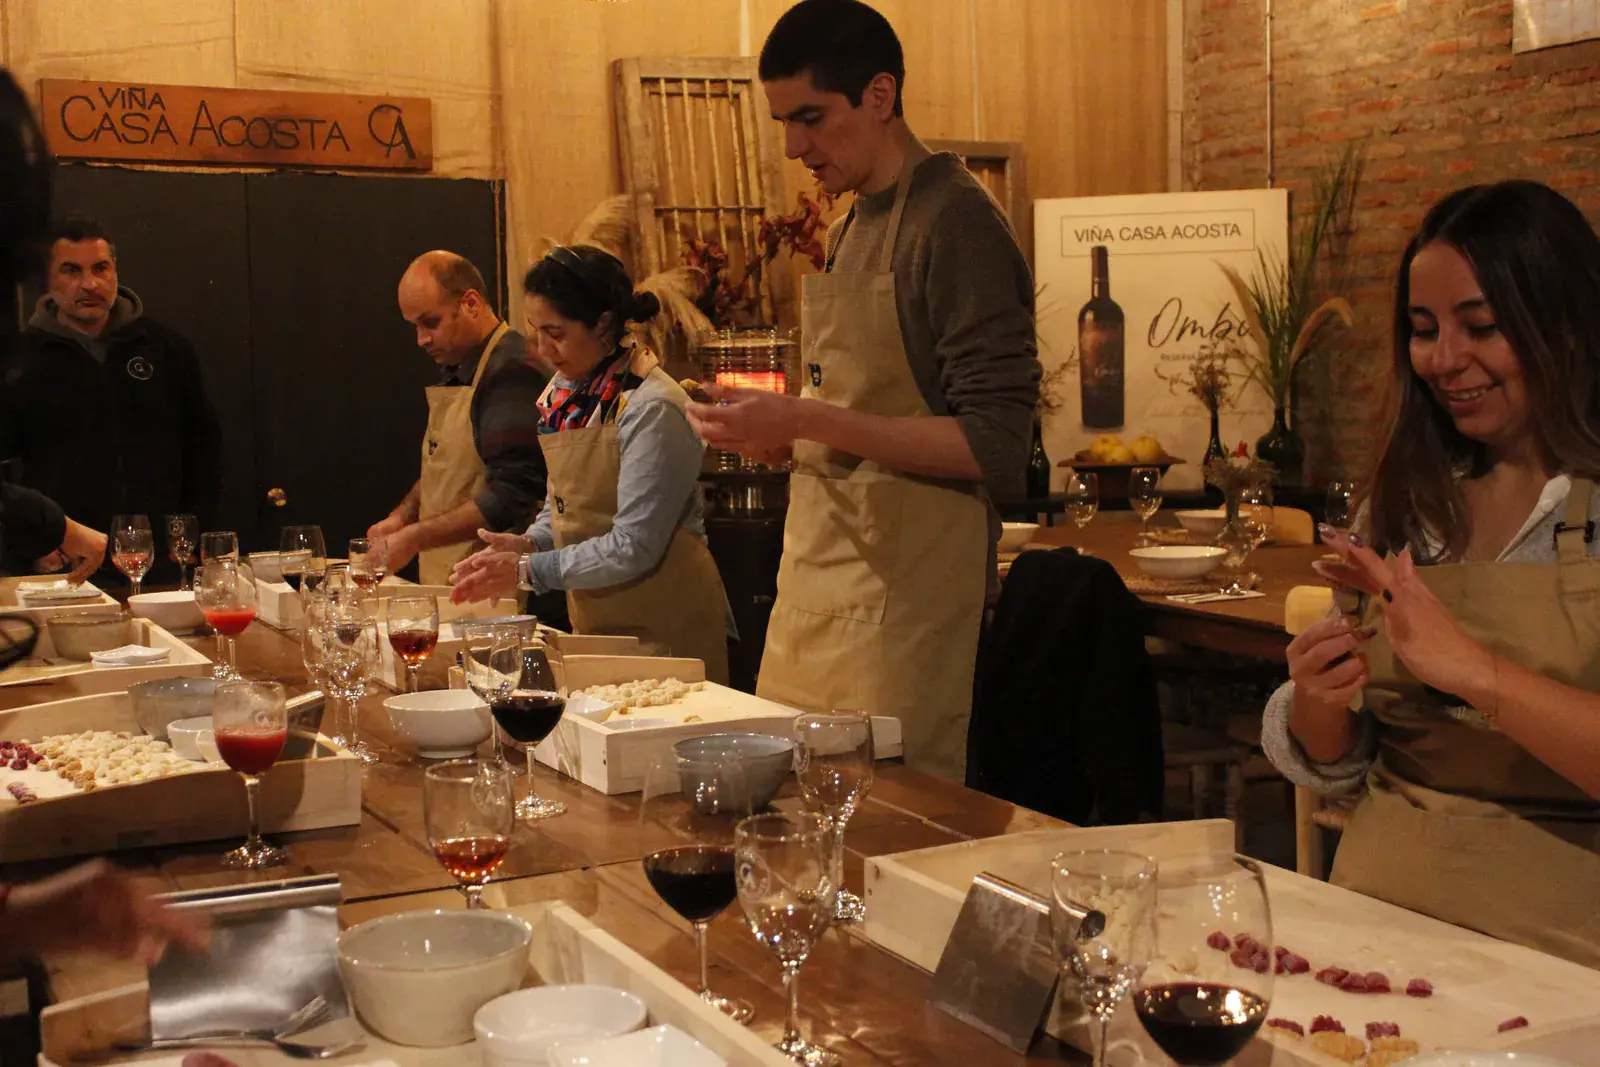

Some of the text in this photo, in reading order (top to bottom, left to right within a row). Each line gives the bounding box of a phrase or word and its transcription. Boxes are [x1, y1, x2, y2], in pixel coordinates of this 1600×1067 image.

[98, 87, 166, 111] VIÑA
[61, 95, 349, 151] CASA ACOSTA
[1074, 223, 1242, 242] VIÑA CASA ACOSTA
